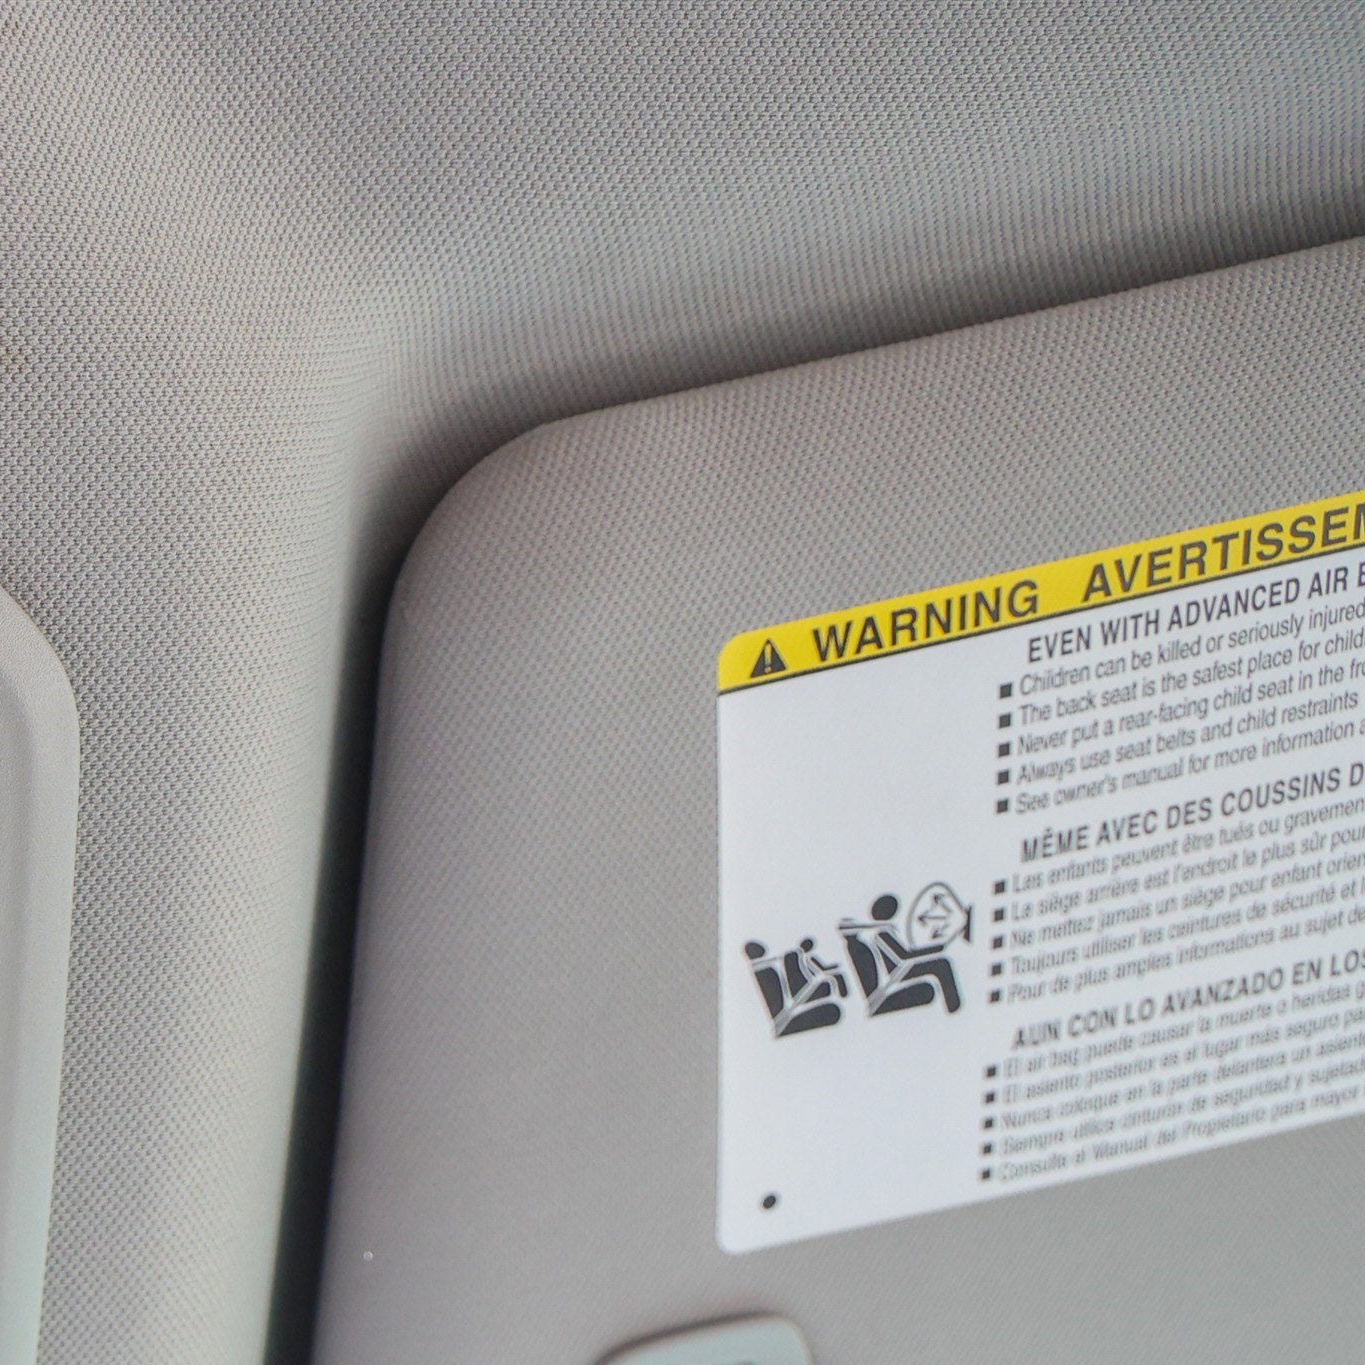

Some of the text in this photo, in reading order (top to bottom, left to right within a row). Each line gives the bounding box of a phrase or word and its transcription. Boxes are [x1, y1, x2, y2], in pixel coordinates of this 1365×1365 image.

[812, 580, 1039, 662] WARNING
[1020, 664, 1090, 696] Children
[1095, 656, 1125, 679] can
[1131, 647, 1152, 671] be
[1157, 635, 1201, 664] killed
[1206, 633, 1223, 653] or
[1227, 613, 1304, 648] seriously
[1028, 625, 1092, 663] EVEN
[1100, 608, 1160, 646] WITH
[1168, 577, 1300, 631] ADVANCED
[1307, 567, 1349, 599] AIR
[1018, 730, 1067, 755] Never
[1071, 717, 1098, 747] put
[1103, 720, 1113, 736] a
[1213, 683, 1253, 709] child
[1257, 673, 1293, 698] seat
[1298, 669, 1312, 691] in
[1319, 664, 1344, 687] the
[1020, 626, 1365, 726] The back seat is the safest place for child
[1097, 810, 1157, 846] AVEC
[1167, 797, 1212, 829] DES
[1221, 768, 1341, 817] COUSSINS
[1330, 949, 1365, 977] LO
